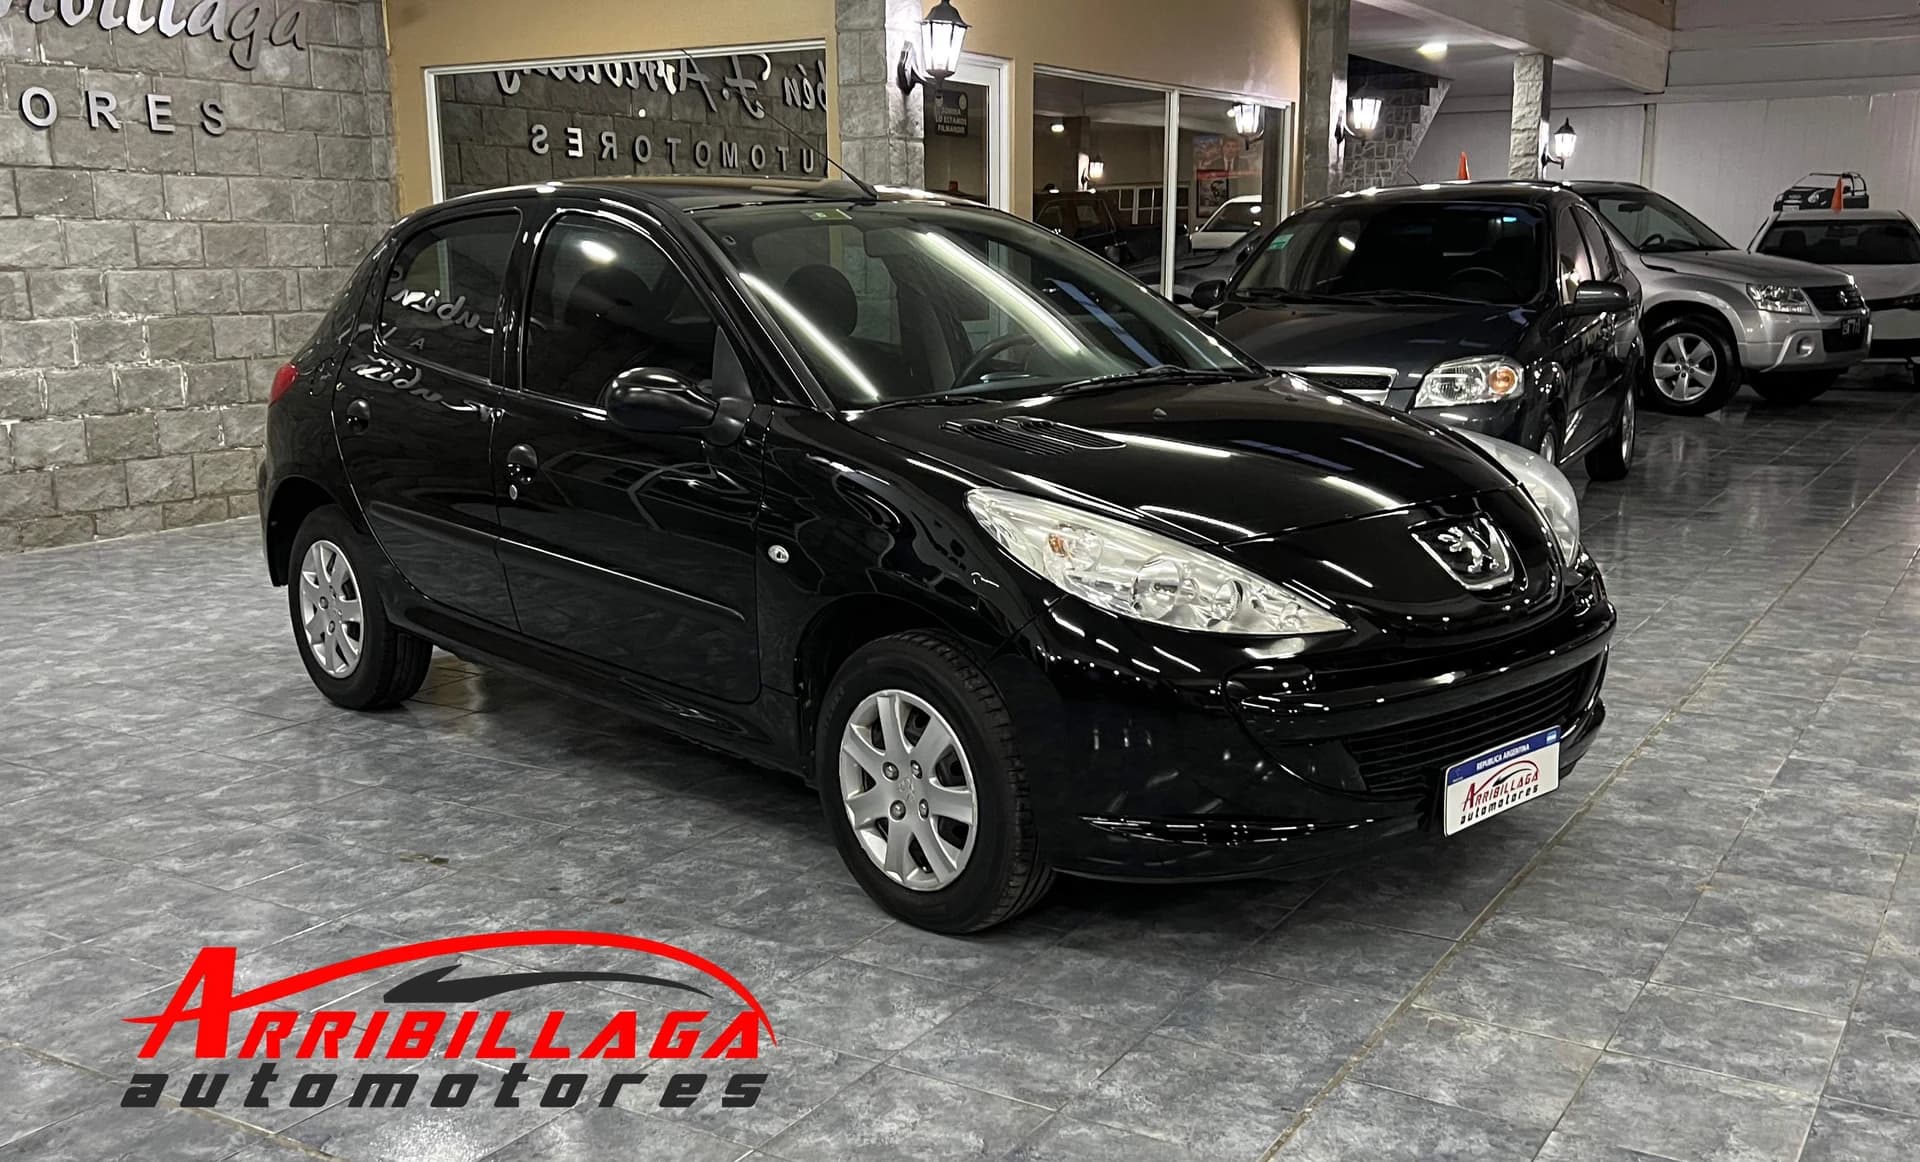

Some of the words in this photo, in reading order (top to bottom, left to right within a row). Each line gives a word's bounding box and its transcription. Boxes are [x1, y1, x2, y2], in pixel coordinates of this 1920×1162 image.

[20, 86, 228, 136] ORES
[1503, 743, 1529, 760] ARGENTINA
[1460, 784, 1539, 825] automotores
